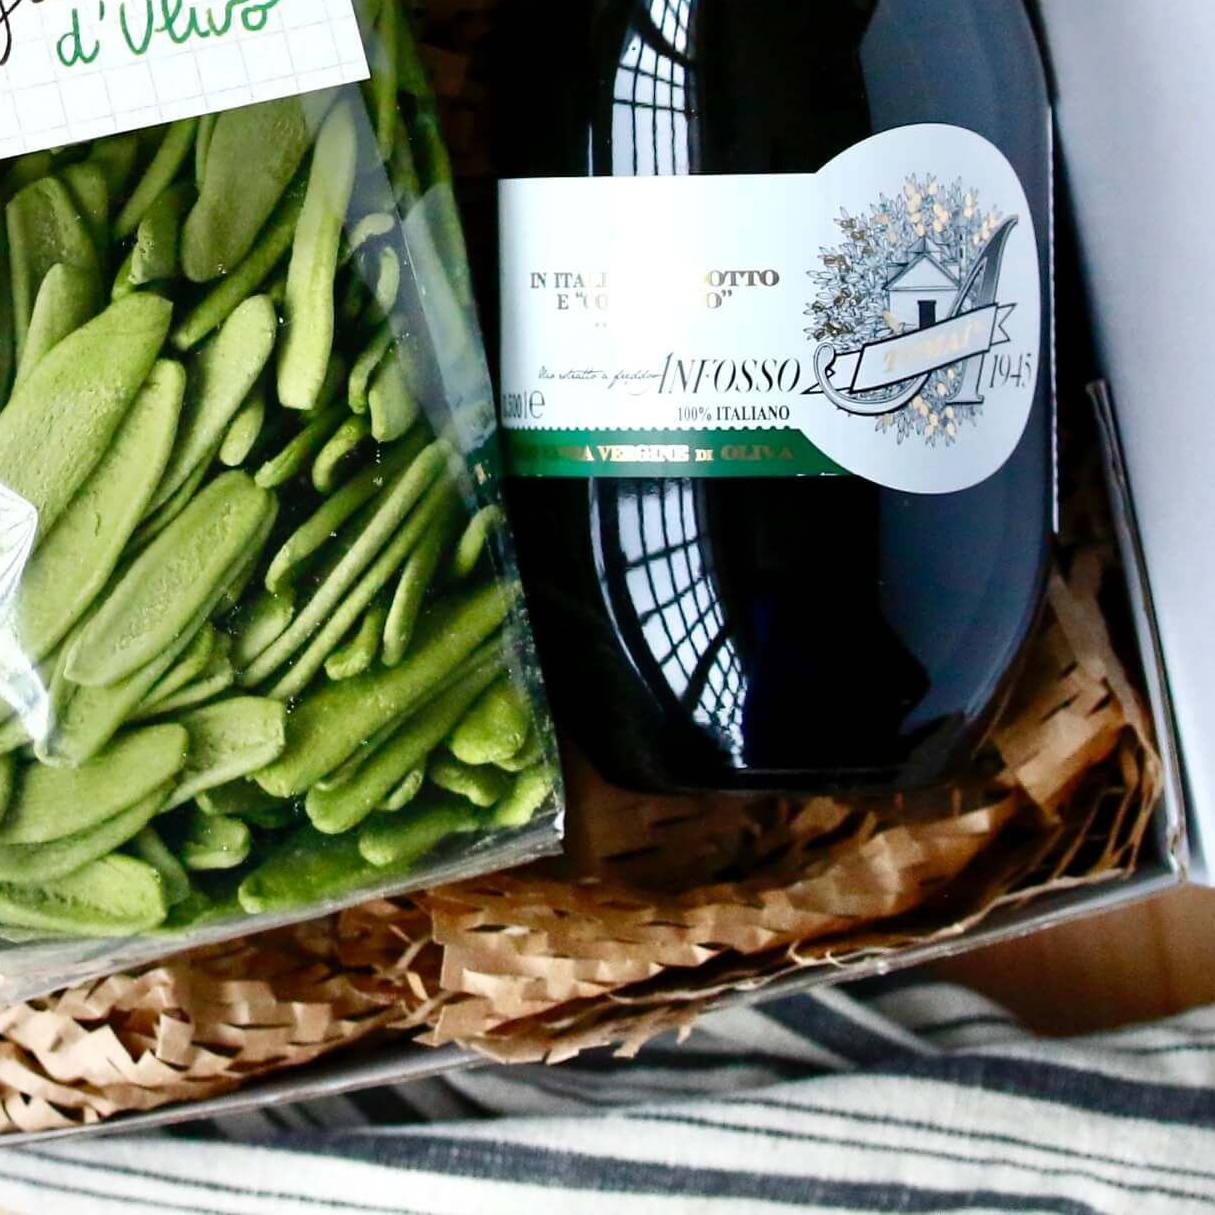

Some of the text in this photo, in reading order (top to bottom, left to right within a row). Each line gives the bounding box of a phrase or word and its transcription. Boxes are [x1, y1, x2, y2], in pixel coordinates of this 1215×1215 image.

[530, 271, 547, 289] IN
[654, 352, 802, 396] ANFOSSO
[989, 353, 1033, 388] 1945
[677, 405, 791, 422] 100% ITALIANO
